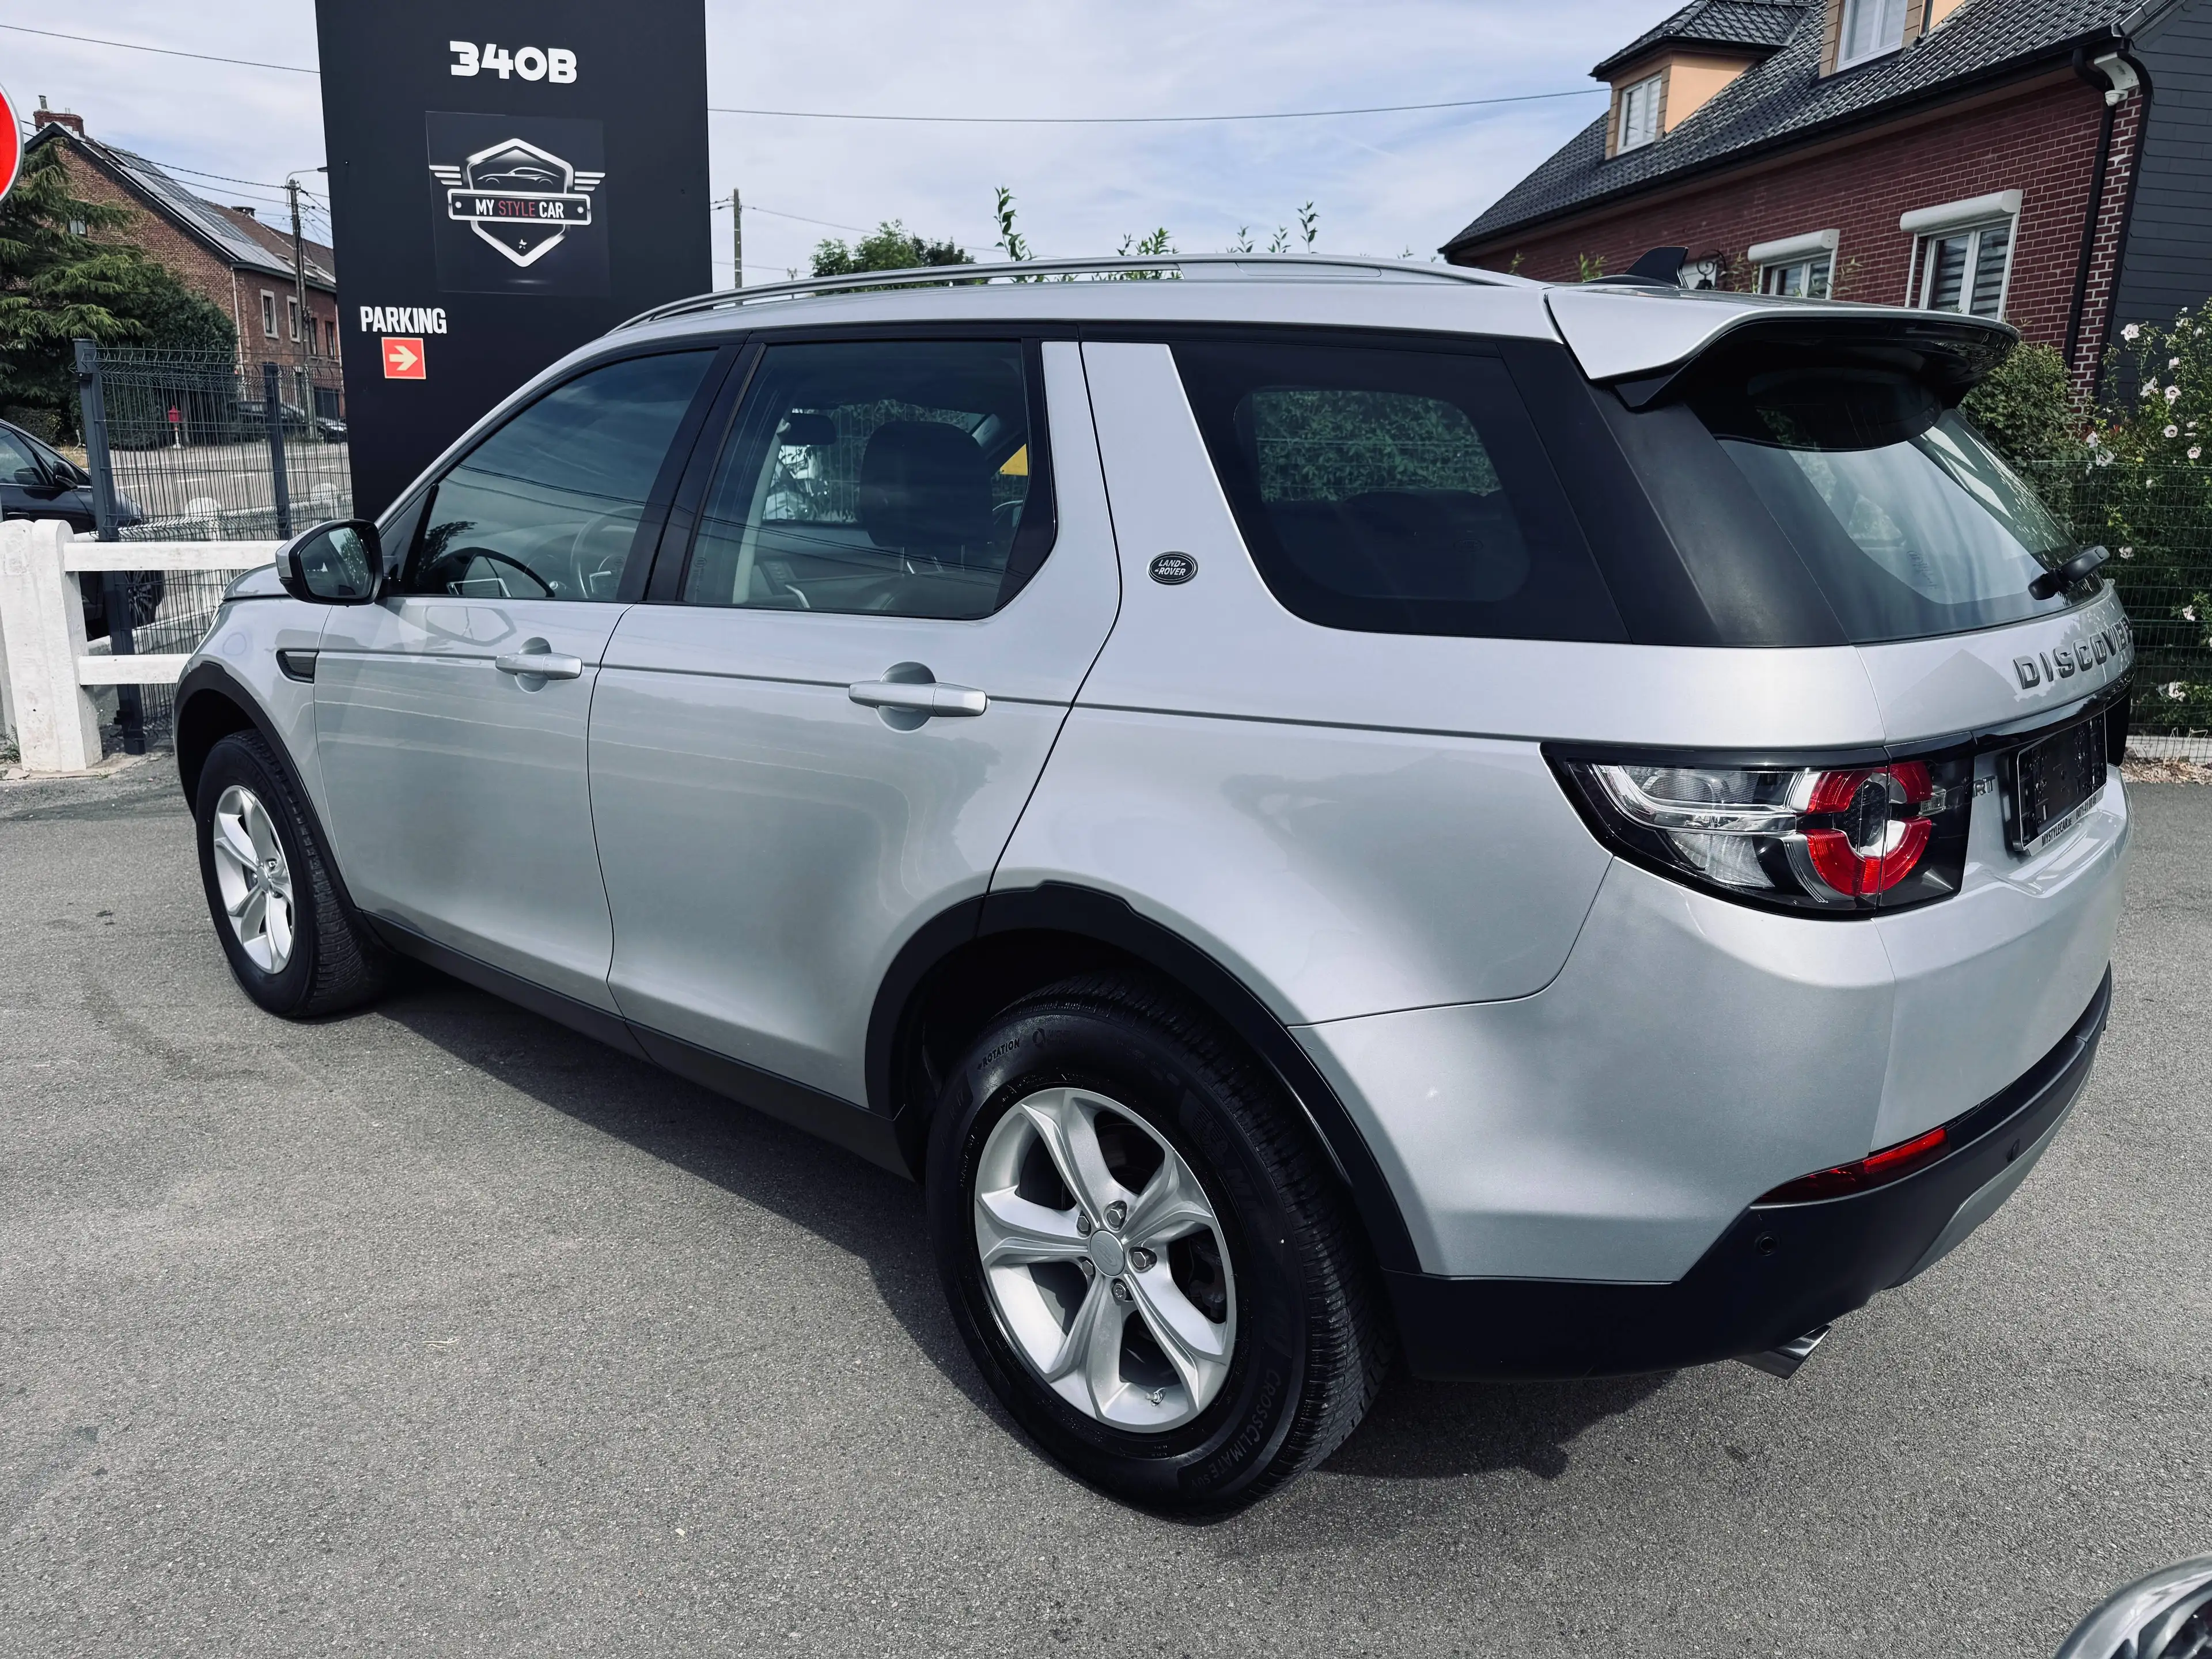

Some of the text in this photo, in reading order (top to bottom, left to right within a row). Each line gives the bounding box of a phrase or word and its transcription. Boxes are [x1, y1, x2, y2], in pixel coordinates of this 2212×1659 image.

[450, 41, 577, 84] 340B
[476, 199, 565, 219] MY STYLE CAR
[360, 306, 448, 334] PARKING
[1158, 559, 1181, 567] LAND
[1158, 567, 1186, 576] ROVER
[983, 1037, 1020, 1067] ROTATION
[1208, 1368, 1282, 1479] CROSSCLIMATE
[1191, 1473, 1211, 1488] SUV
